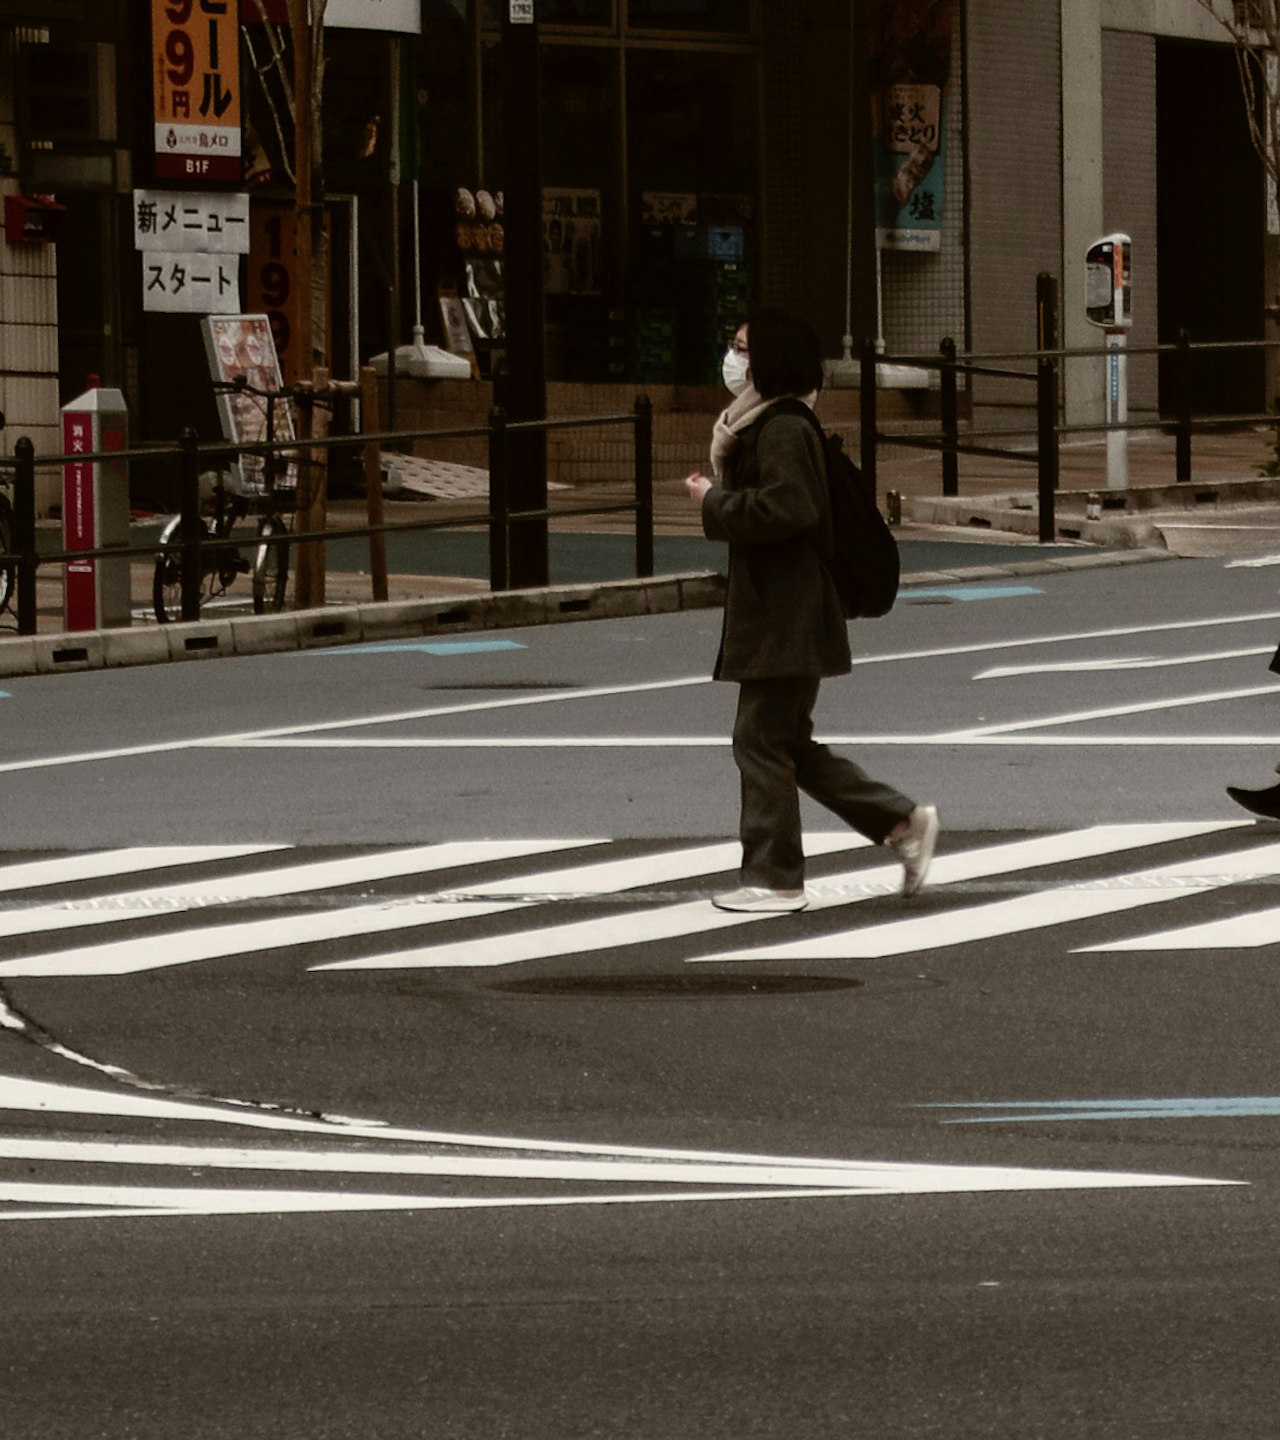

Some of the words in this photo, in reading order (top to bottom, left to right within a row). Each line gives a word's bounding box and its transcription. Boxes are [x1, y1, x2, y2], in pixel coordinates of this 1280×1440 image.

[185, 159, 210, 174] B1F
[137, 200, 245, 234] 新メニュー
[909, 192, 935, 221] 塩
[147, 264, 231, 295] スタート
